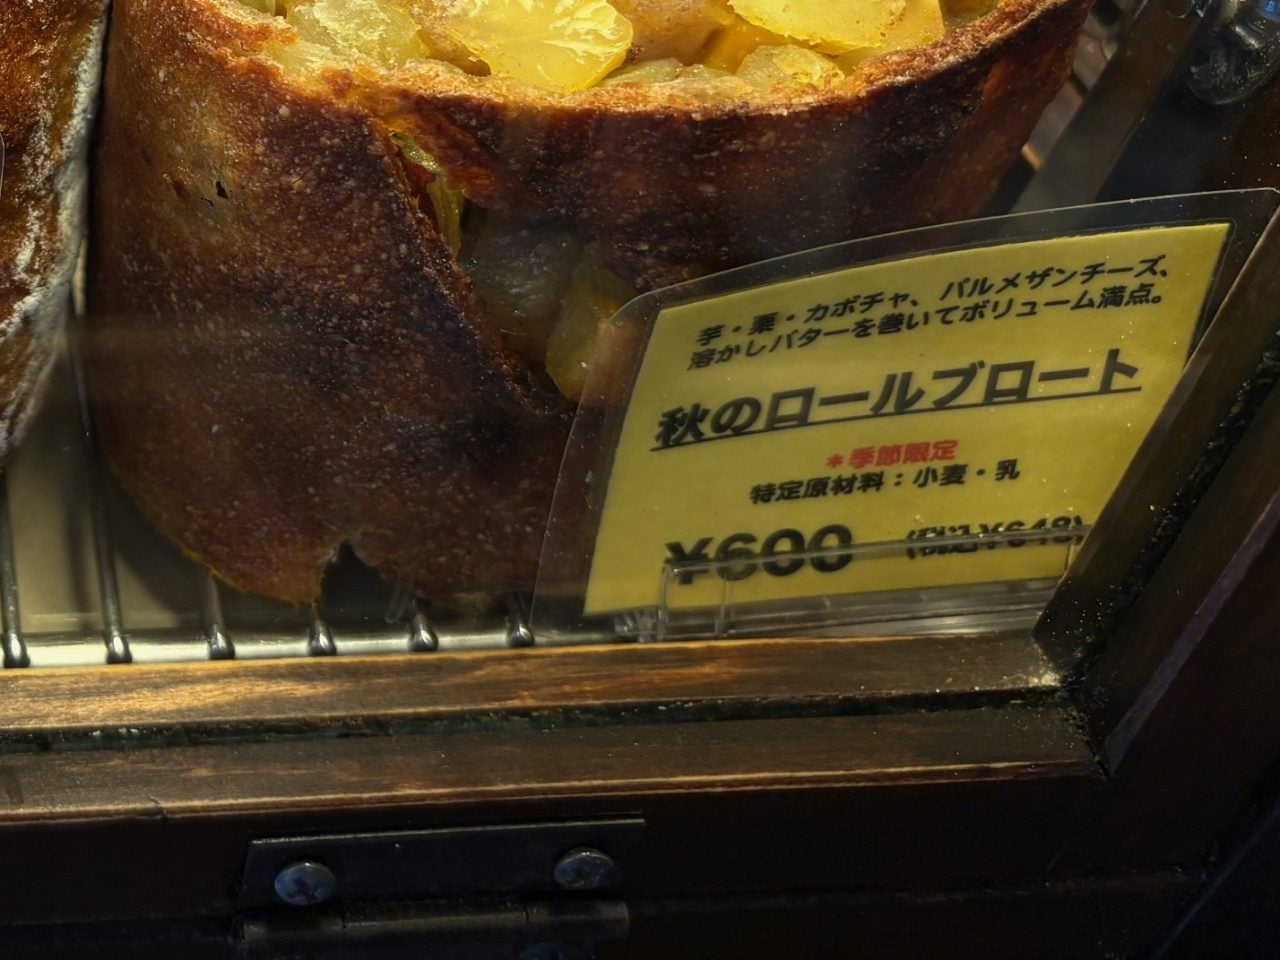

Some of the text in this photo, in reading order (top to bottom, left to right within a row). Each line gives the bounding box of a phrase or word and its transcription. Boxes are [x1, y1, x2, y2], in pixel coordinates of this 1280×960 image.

[686, 283, 1162, 371] 溶かしバターを巻いてボリューム満点。
[695, 254, 1168, 345] 芋・栗・カボチャ、パルメザンチーズ、
[653, 348, 1138, 445] 秋のロールブロート
[749, 459, 1020, 504] 特定原材料：小麦・乳
